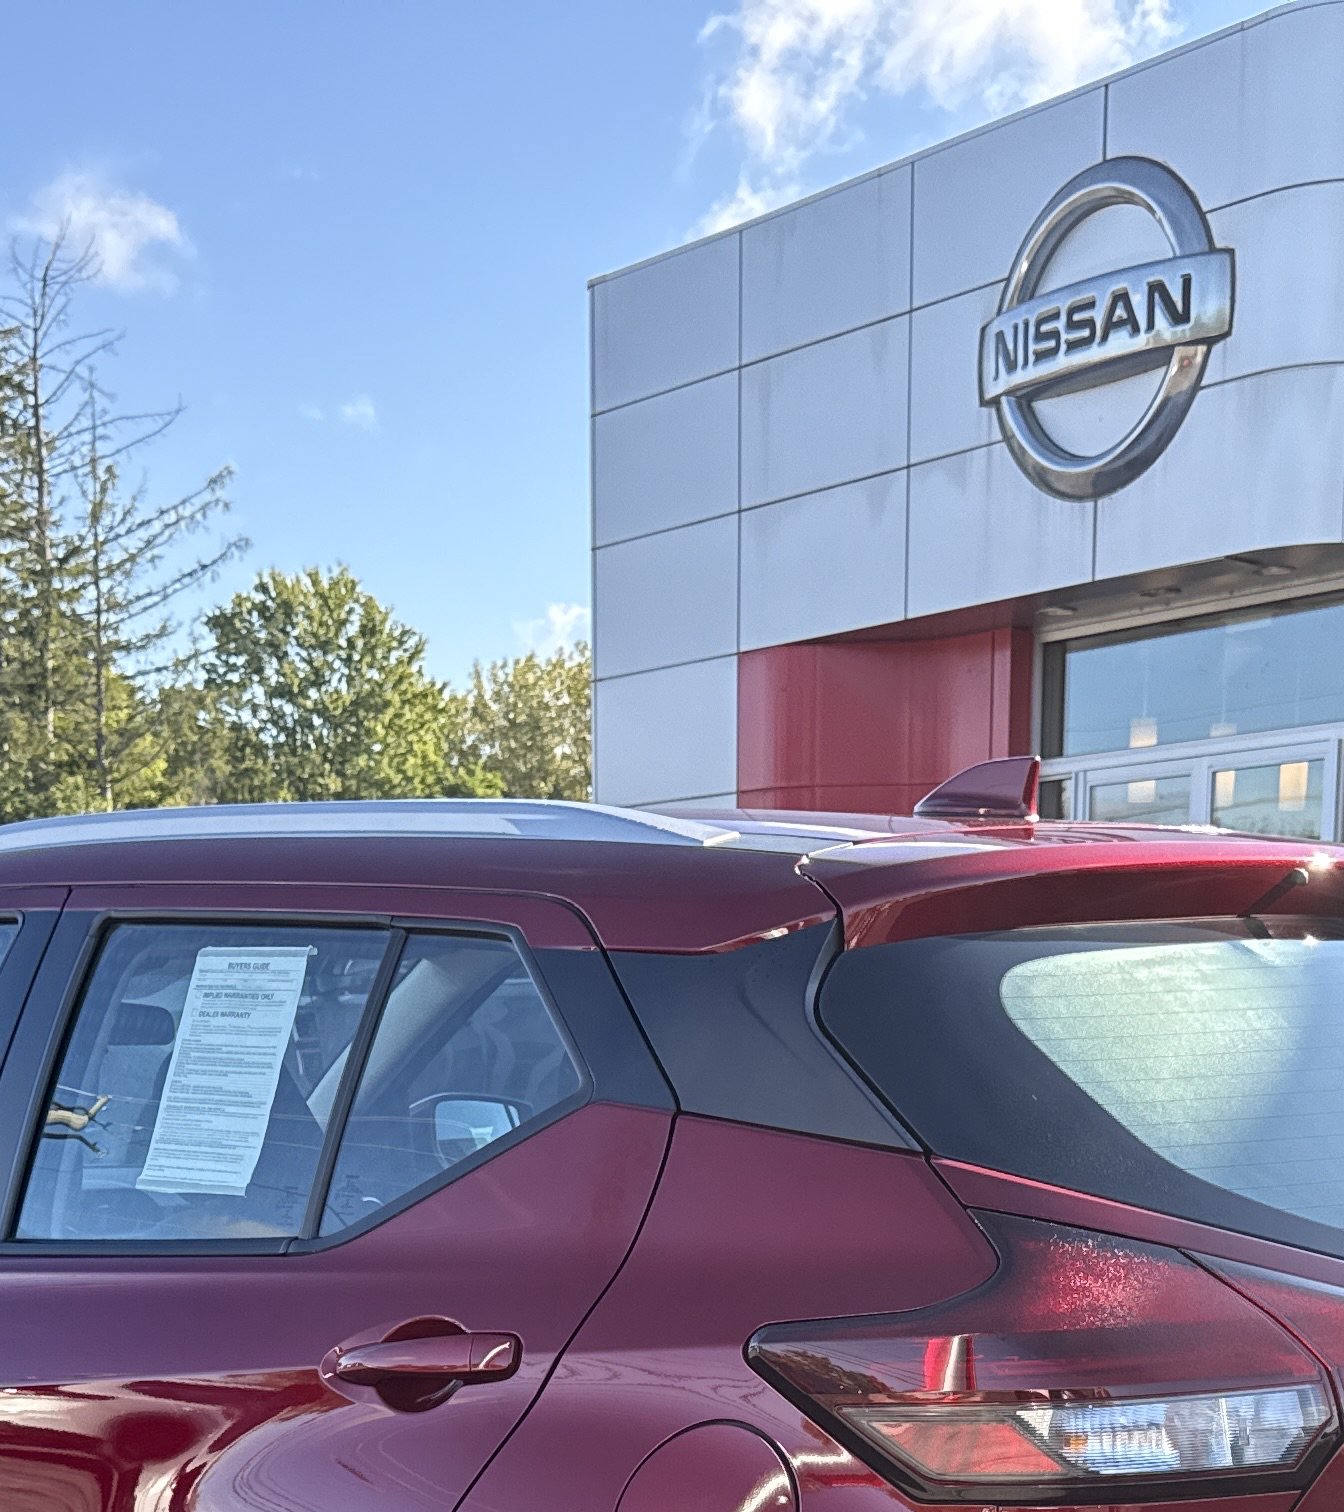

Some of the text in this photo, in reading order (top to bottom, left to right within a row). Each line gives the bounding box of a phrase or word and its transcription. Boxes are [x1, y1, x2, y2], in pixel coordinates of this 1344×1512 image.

[993, 272, 1193, 382] NISSAN
[228, 962, 271, 970] BUYERS GUIDE
